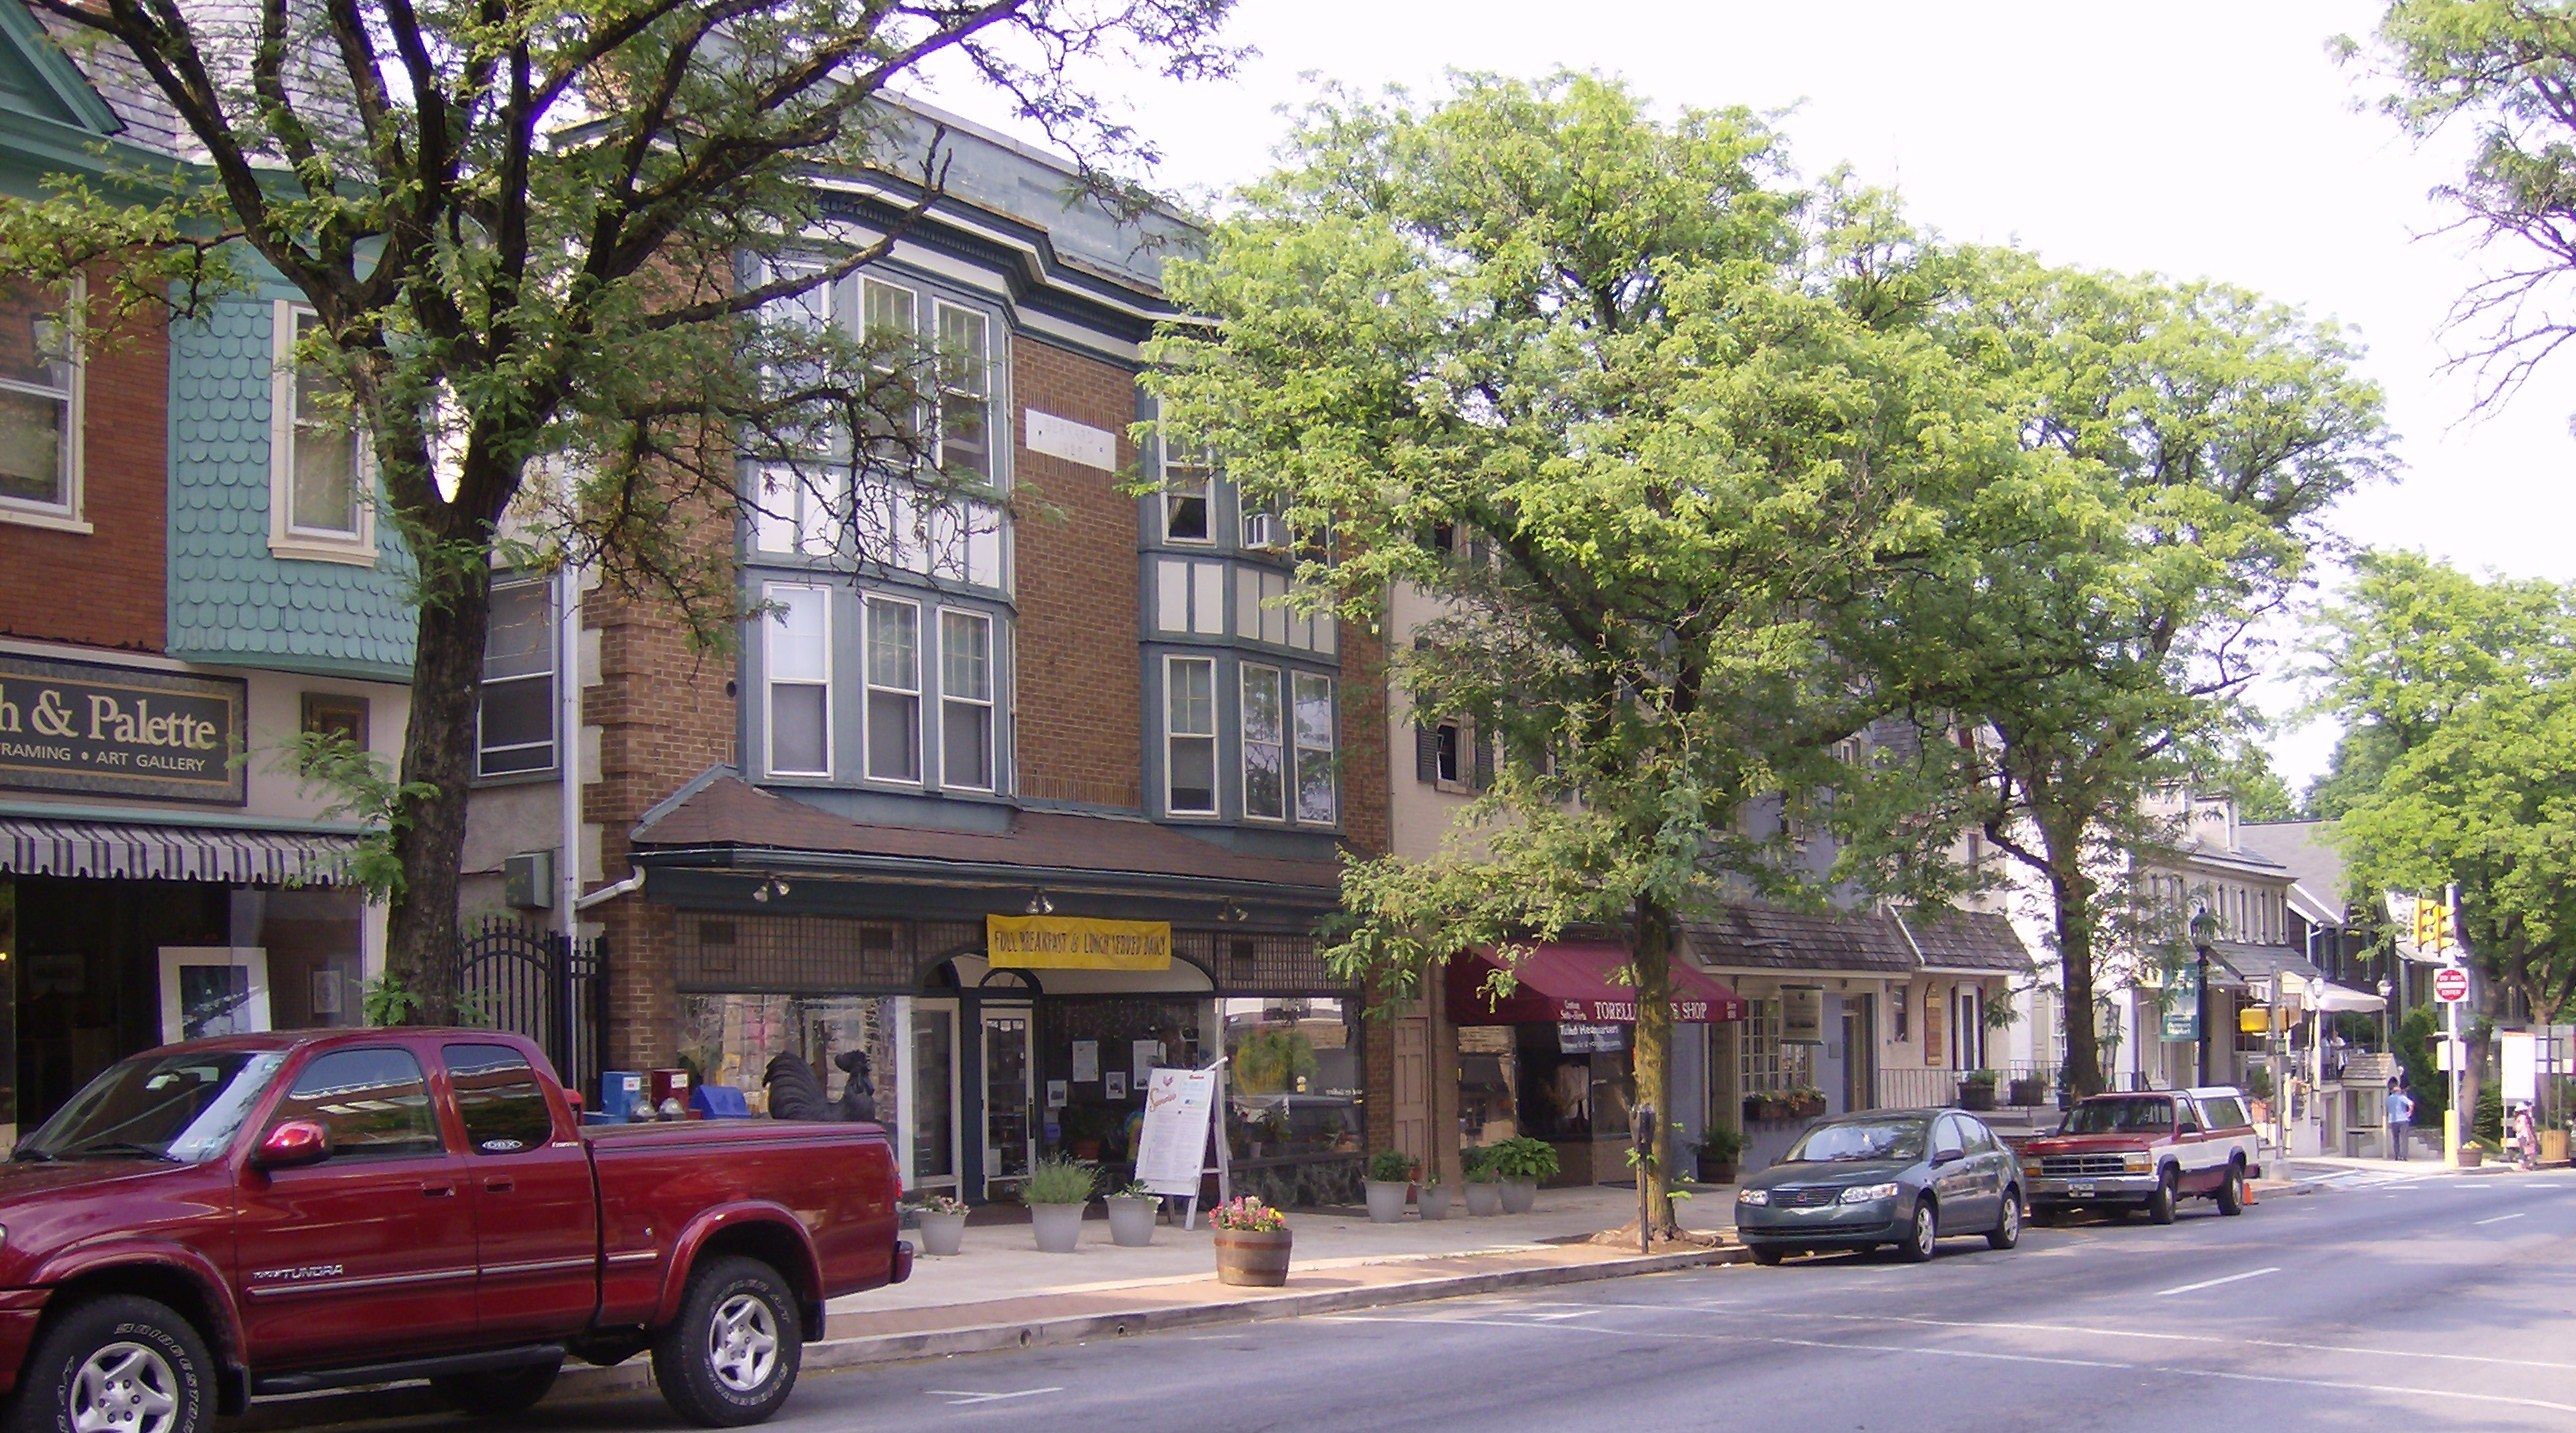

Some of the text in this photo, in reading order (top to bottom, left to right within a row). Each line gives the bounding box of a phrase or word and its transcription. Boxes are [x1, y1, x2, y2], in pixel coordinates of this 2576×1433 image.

[31, 690, 79, 737] &
[87, 694, 217, 751] Palette
[0, 742, 206, 772] RAMING ART GALLERY
[1682, 1002, 1708, 1020] SHOP
[280, 1264, 344, 1279] TUNDRA
